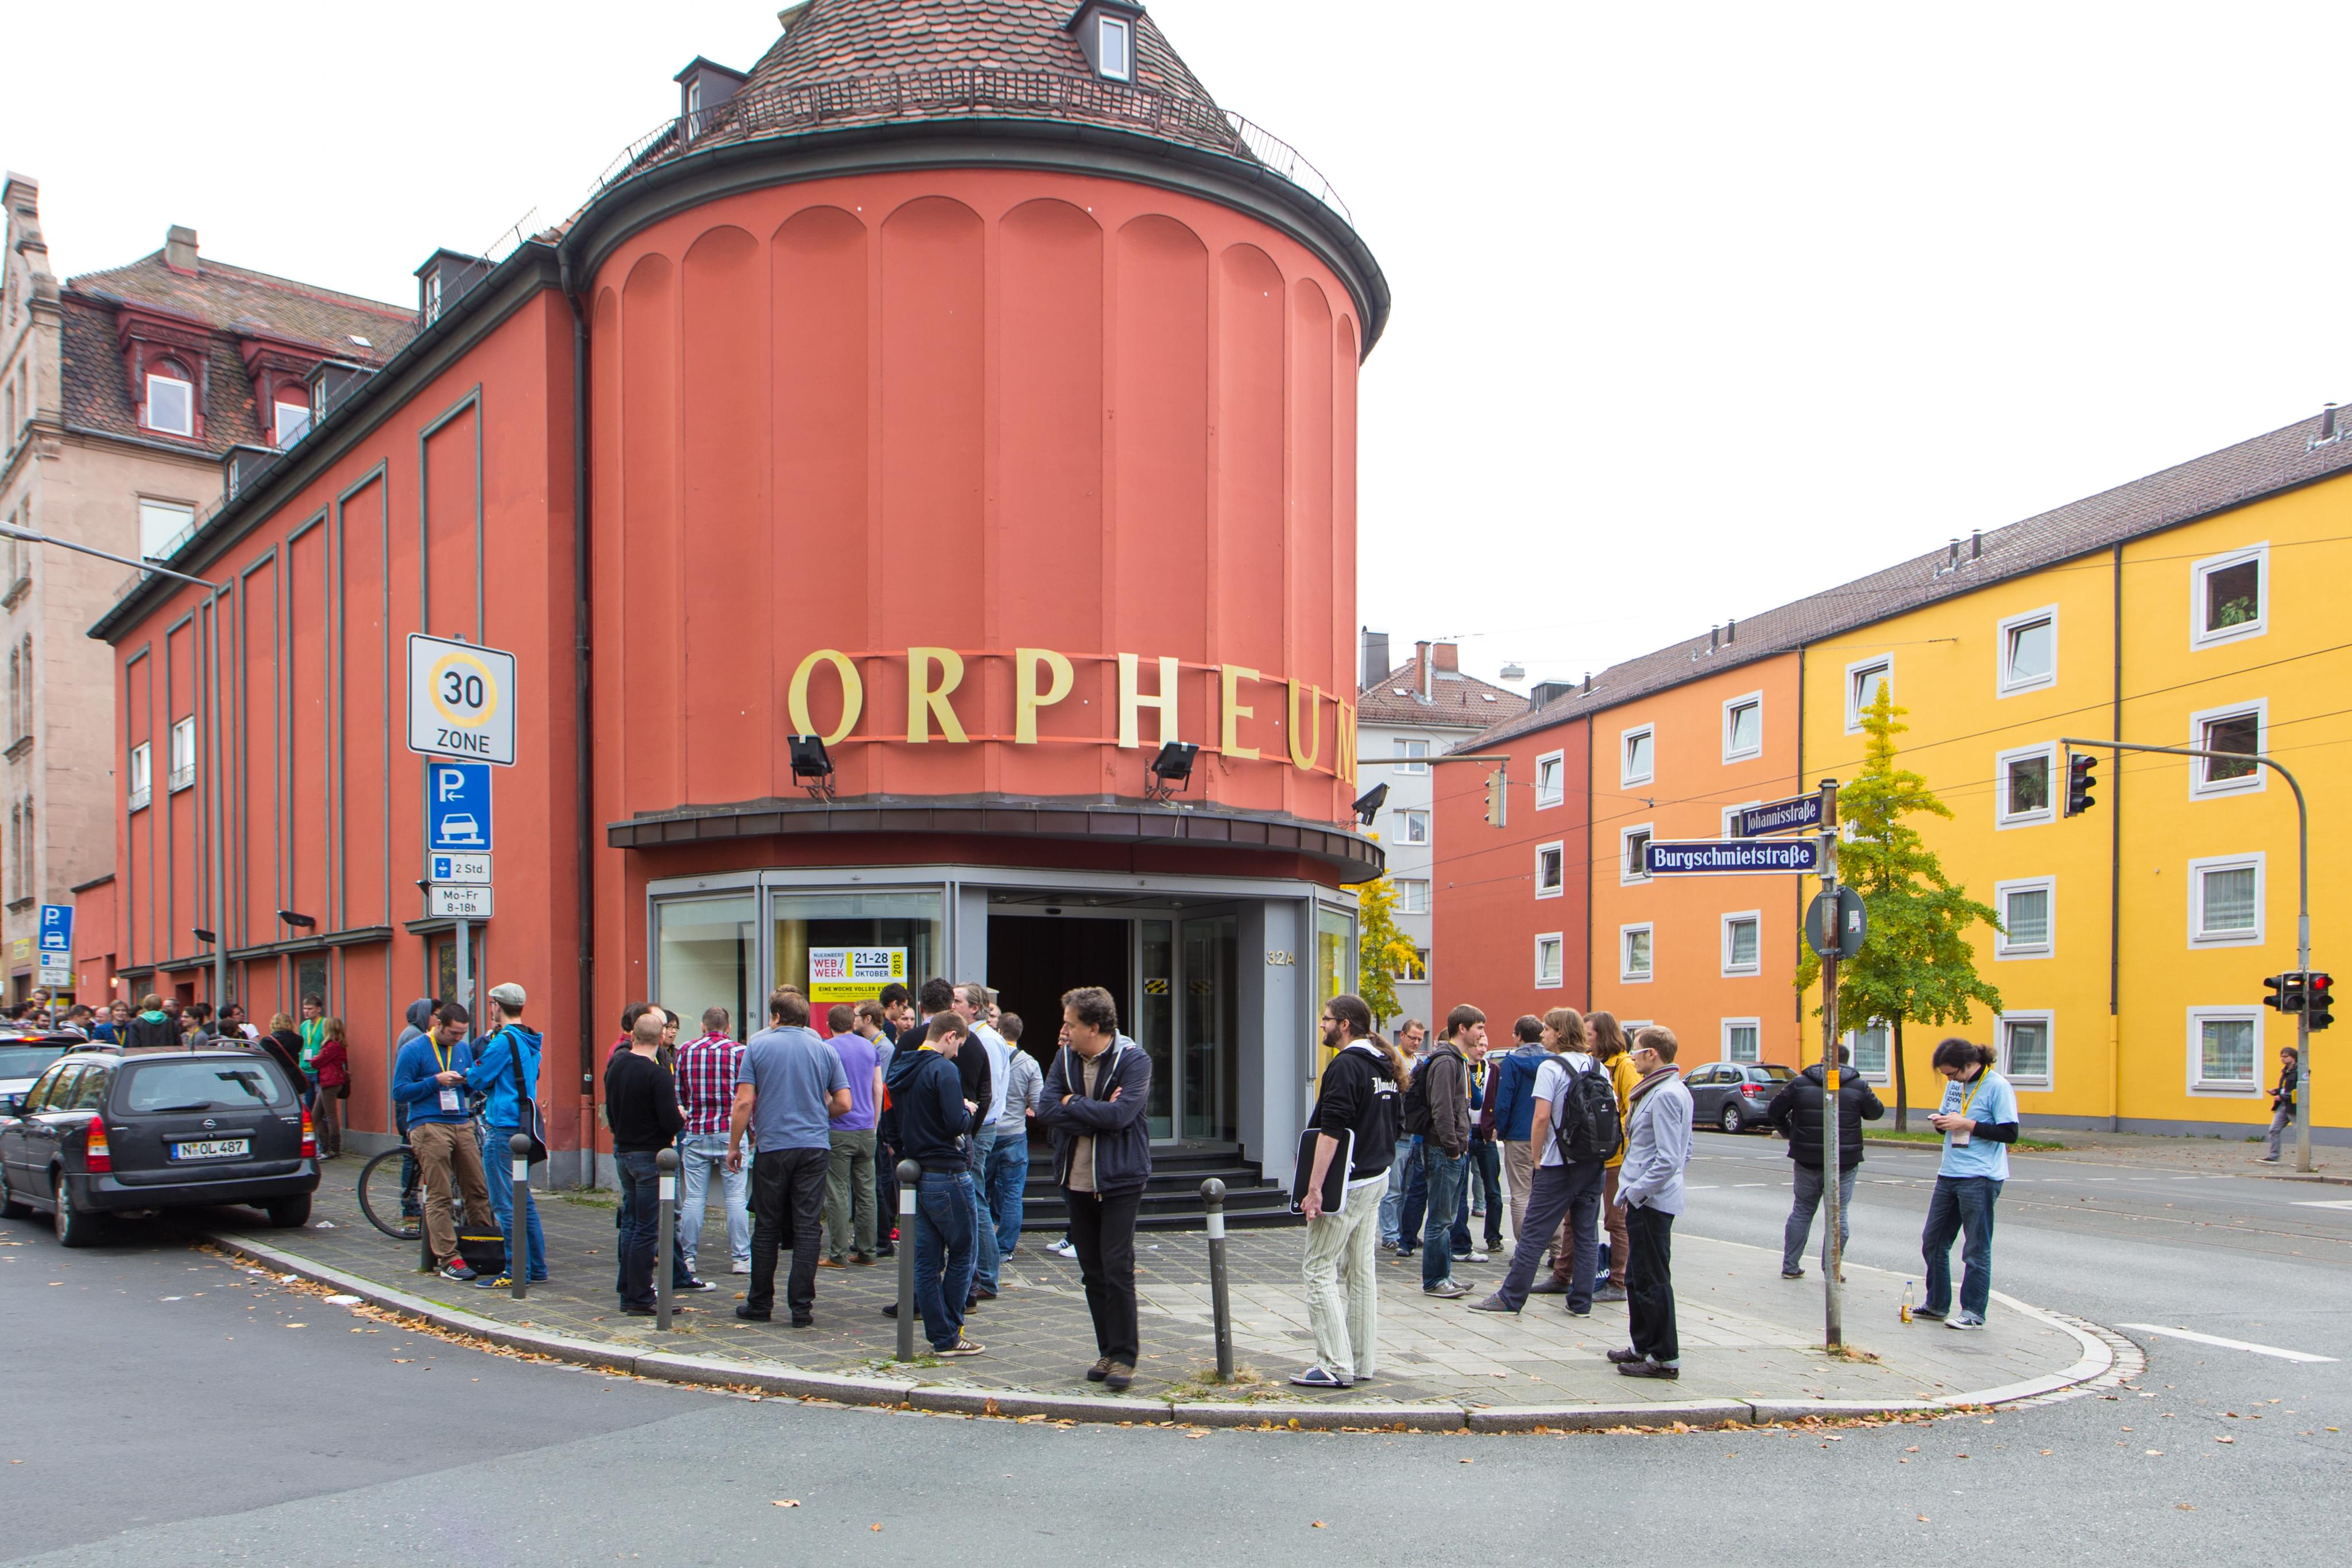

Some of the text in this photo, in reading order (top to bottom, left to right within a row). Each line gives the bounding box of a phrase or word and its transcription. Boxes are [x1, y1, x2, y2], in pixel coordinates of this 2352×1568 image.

[444, 671, 483, 708] 30
[788, 646, 1357, 789] ORPHEUM
[437, 728, 489, 753] ZONE
[439, 769, 465, 802] P
[1747, 800, 1816, 833] Johannisstraße
[1655, 844, 1810, 870] Burgschmietstraße
[456, 864, 485, 873] 2 Std.
[444, 891, 478, 900] Mo-Fr
[447, 903, 476, 912] 8-18h
[45, 908, 60, 925] P
[815, 959, 837, 968] WEB
[855, 953, 888, 963] 21-28
[1267, 950, 1295, 965] 32A
[815, 969, 844, 977] WEEK
[183, 1141, 242, 1156] N OL 487
